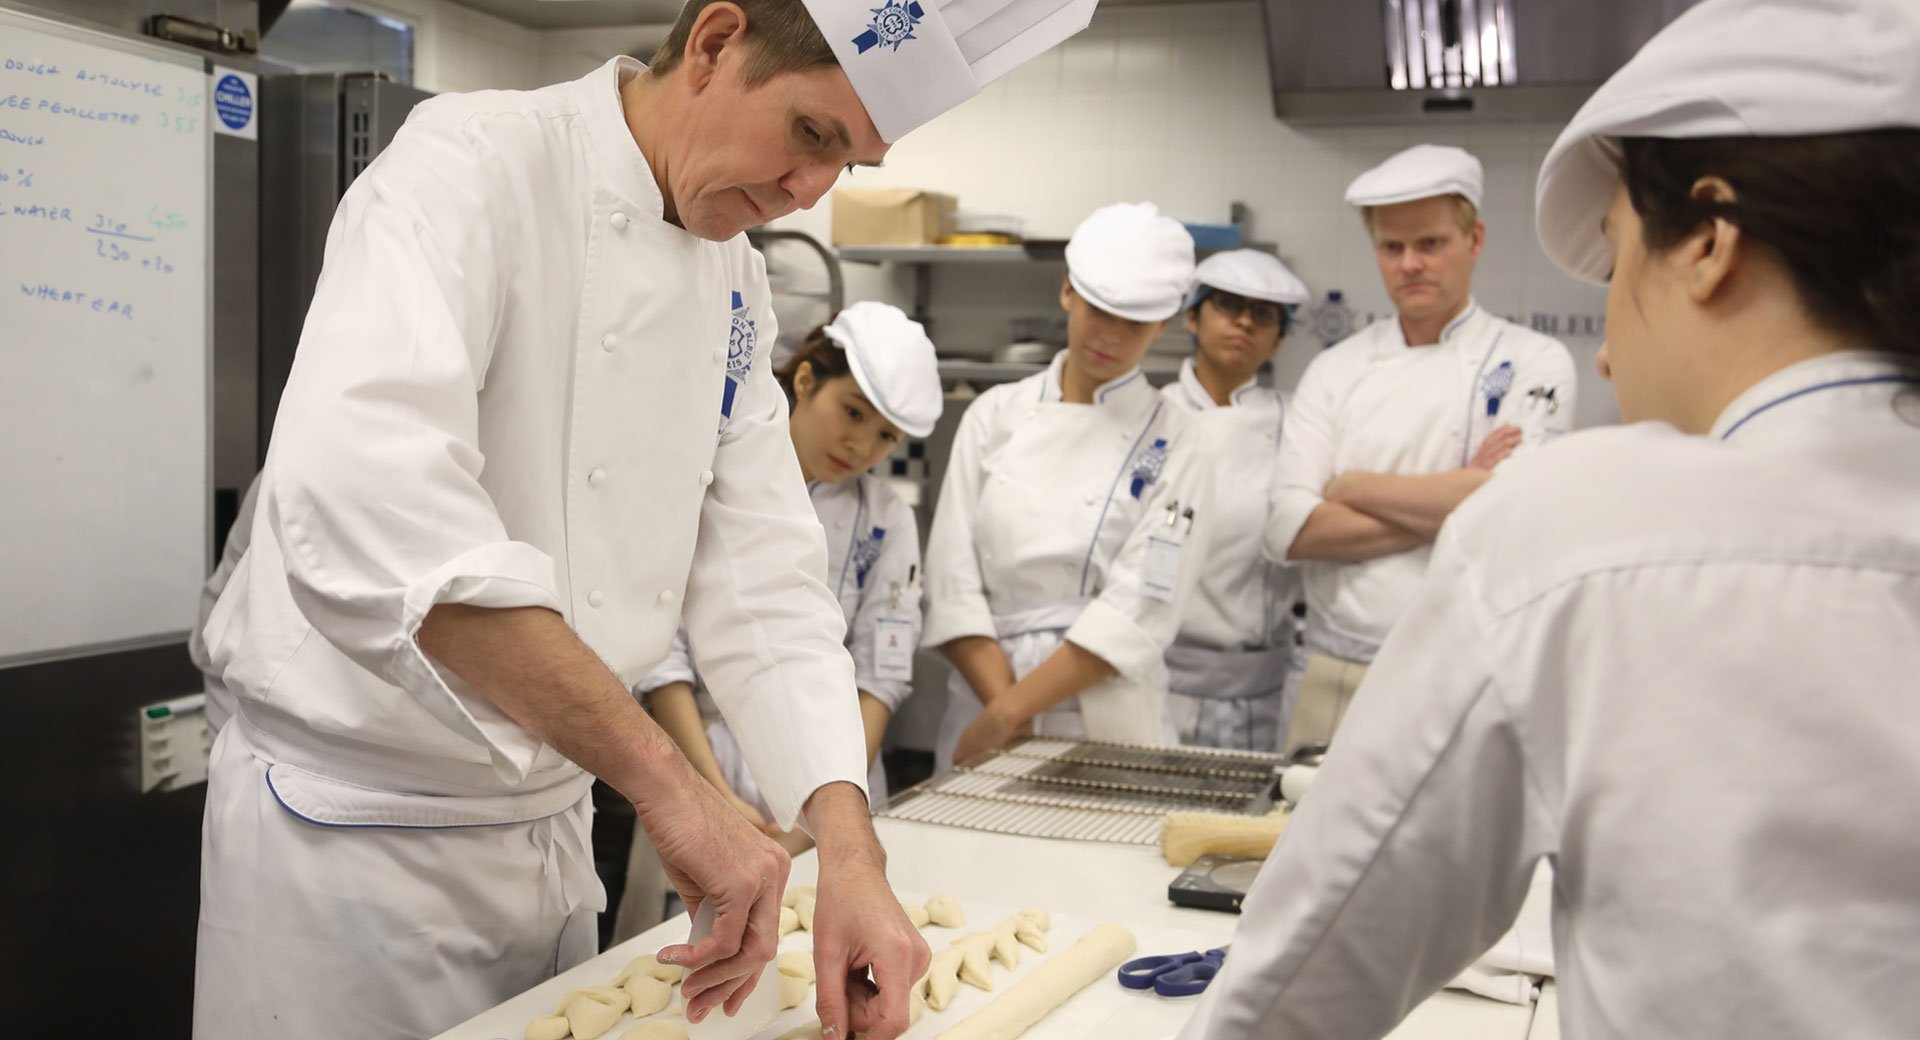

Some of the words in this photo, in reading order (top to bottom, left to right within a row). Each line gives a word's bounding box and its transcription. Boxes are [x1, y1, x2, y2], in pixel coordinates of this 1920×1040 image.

[14, 204, 72, 221] WATER
[20, 283, 87, 303] WHEAT
[91, 298, 134, 321] EAR
